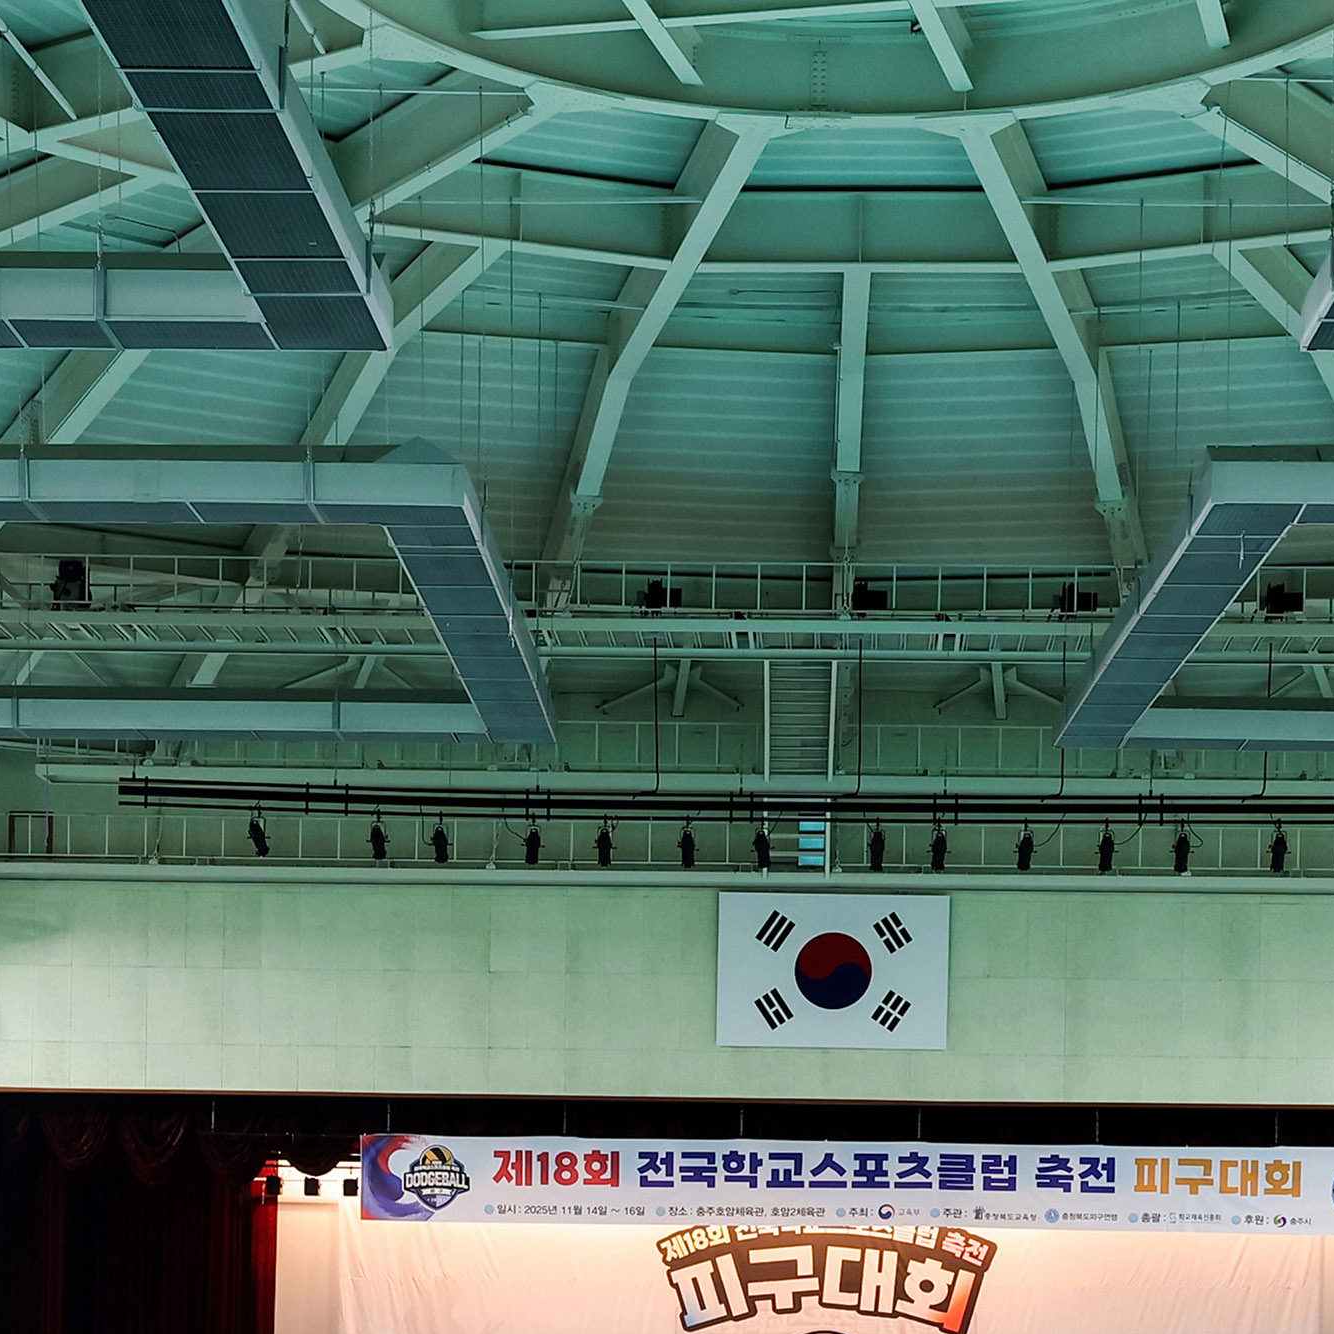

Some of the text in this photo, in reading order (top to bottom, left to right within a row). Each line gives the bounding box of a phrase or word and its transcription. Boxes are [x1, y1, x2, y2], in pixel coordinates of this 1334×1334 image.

[405, 1171, 468, 1189] DODGEBALL
[492, 1149, 621, 1188] 제18회
[636, 1150, 1018, 1189] 전국학교스포츠클럽
[1034, 1154, 1116, 1195] 축전
[1134, 1157, 1302, 1198] 피구대회
[524, 1204, 557, 1215] 2025년
[562, 1205, 582, 1215] 11월
[586, 1206, 607, 1216] 14일
[624, 1206, 645, 1216] 16일
[660, 1226, 731, 1262] 제18회
[942, 1231, 989, 1267] 축전
[671, 1245, 976, 1333] 피구대회
